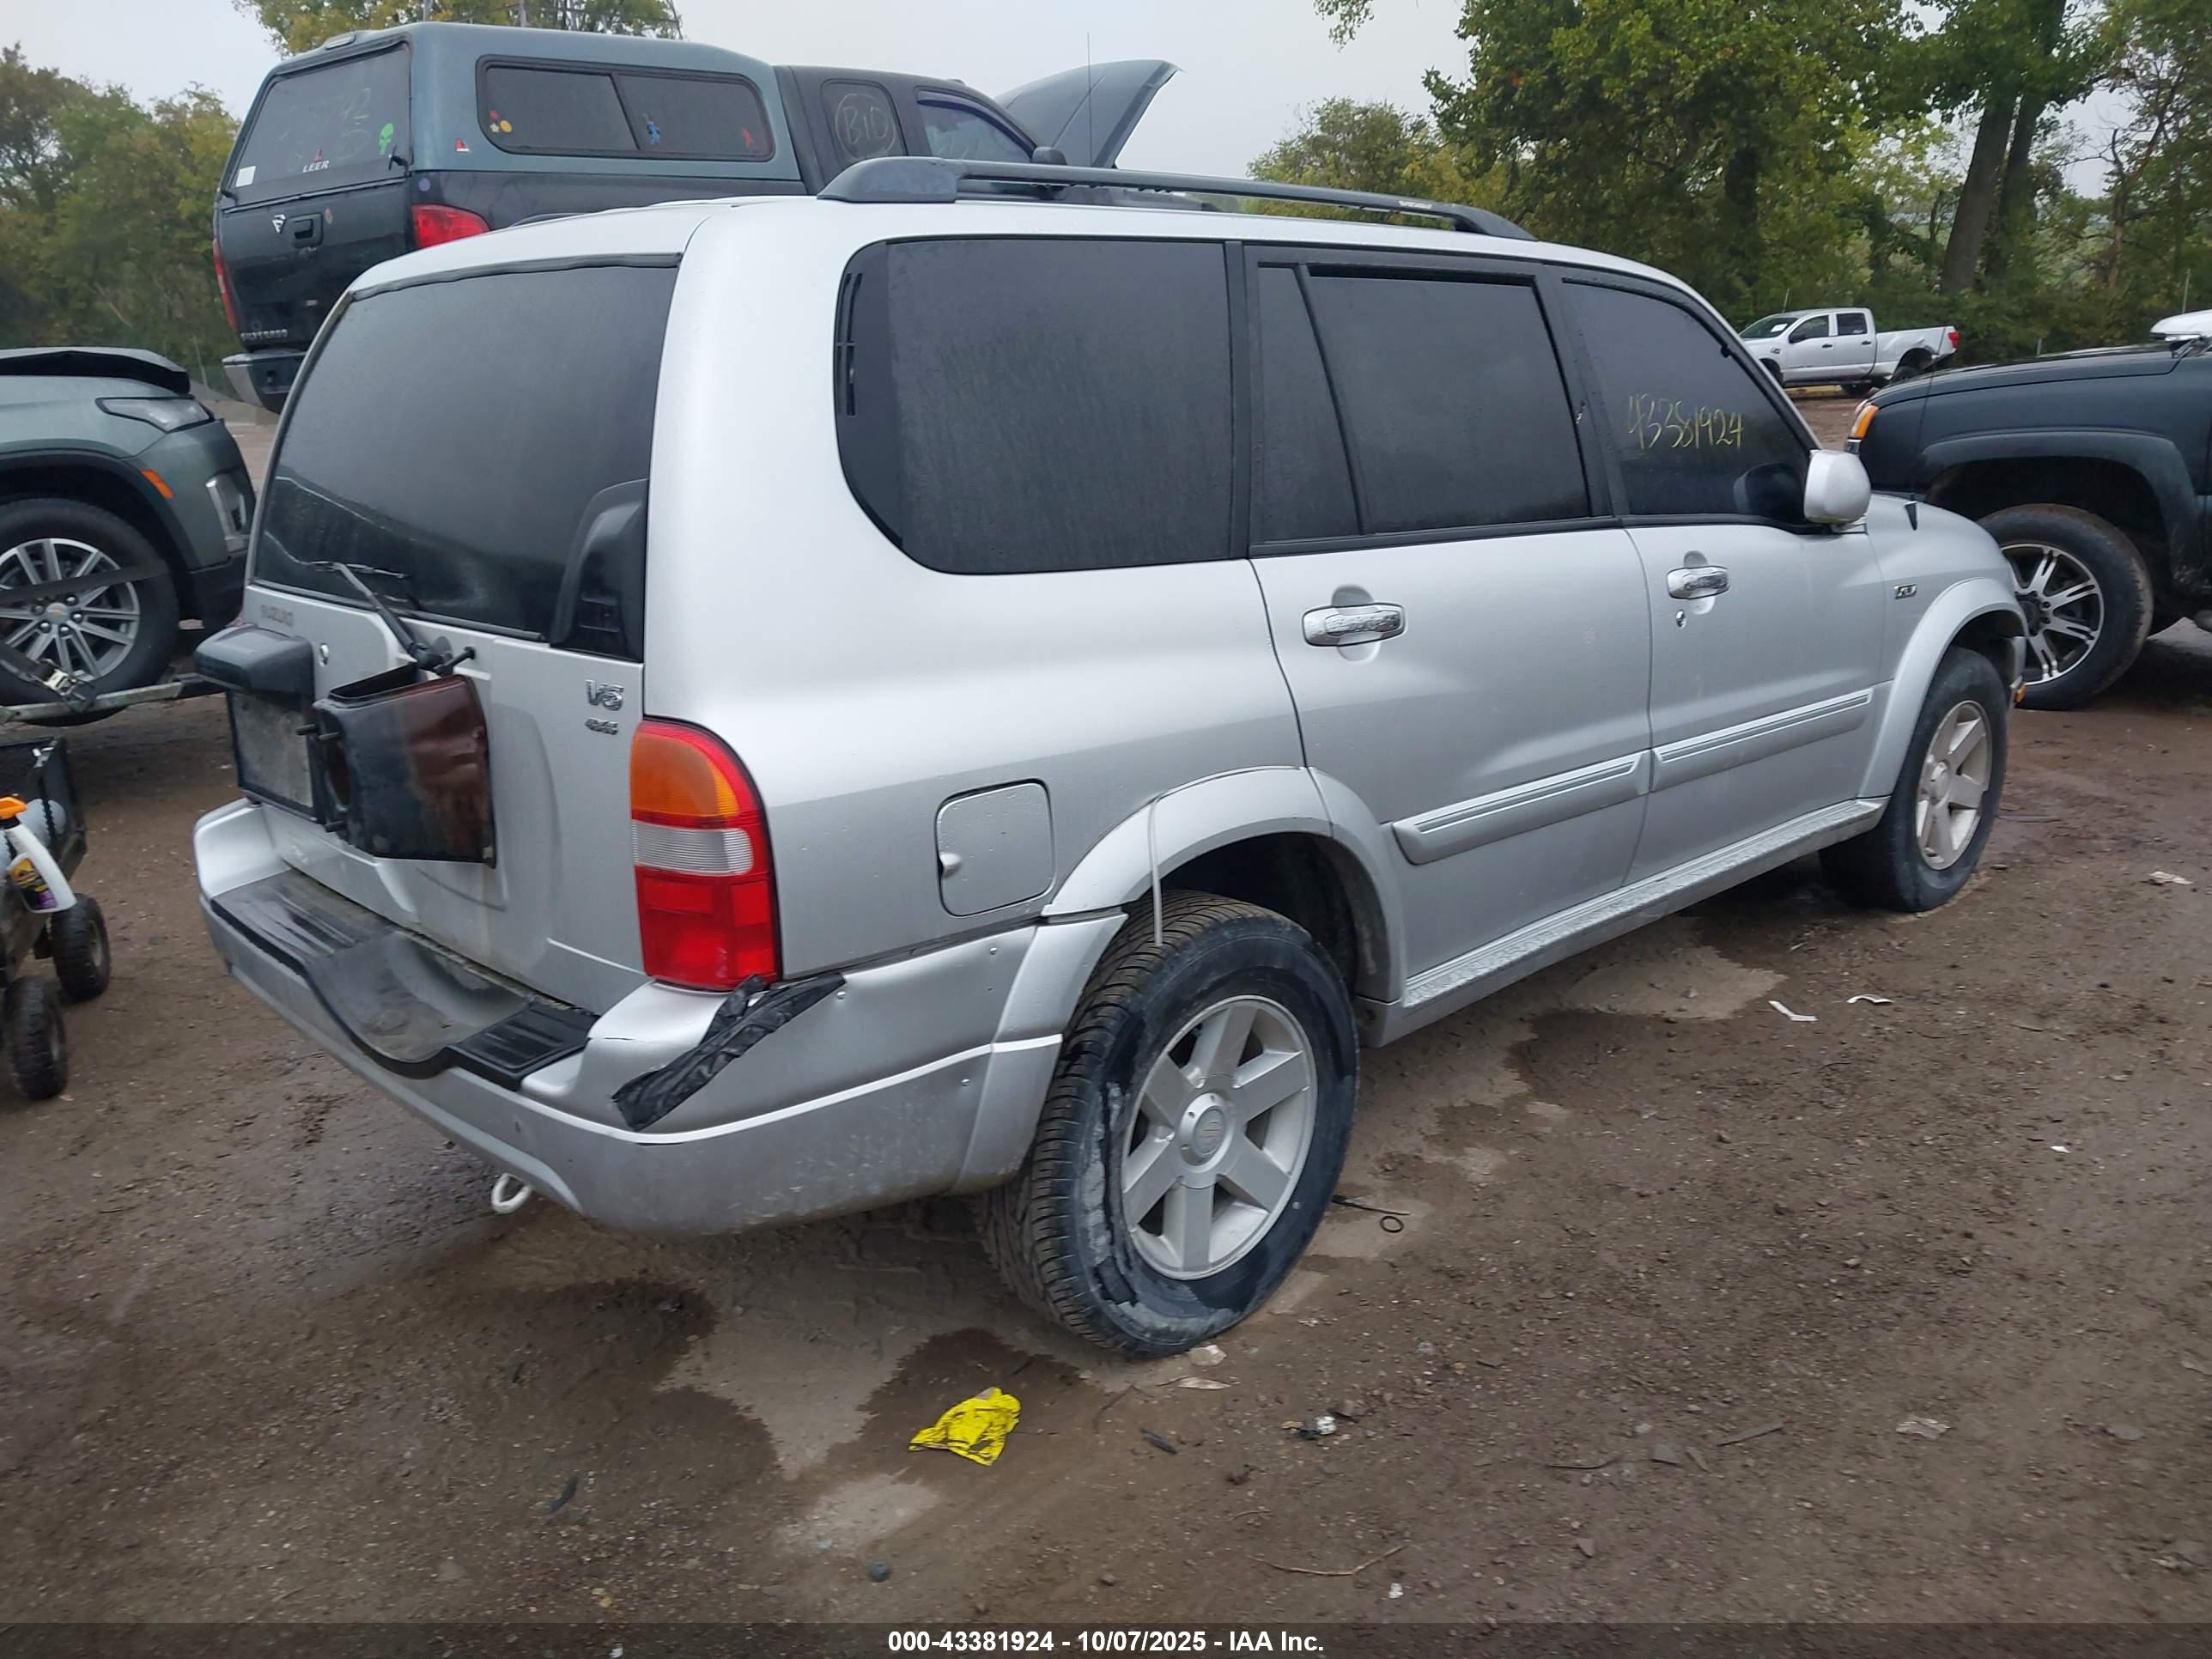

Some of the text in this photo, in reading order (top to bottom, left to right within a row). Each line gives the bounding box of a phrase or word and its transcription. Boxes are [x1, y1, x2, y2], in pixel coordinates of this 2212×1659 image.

[302, 160, 330, 173] LEER
[1628, 393, 1745, 450] 43381924
[585, 679, 625, 711] V6
